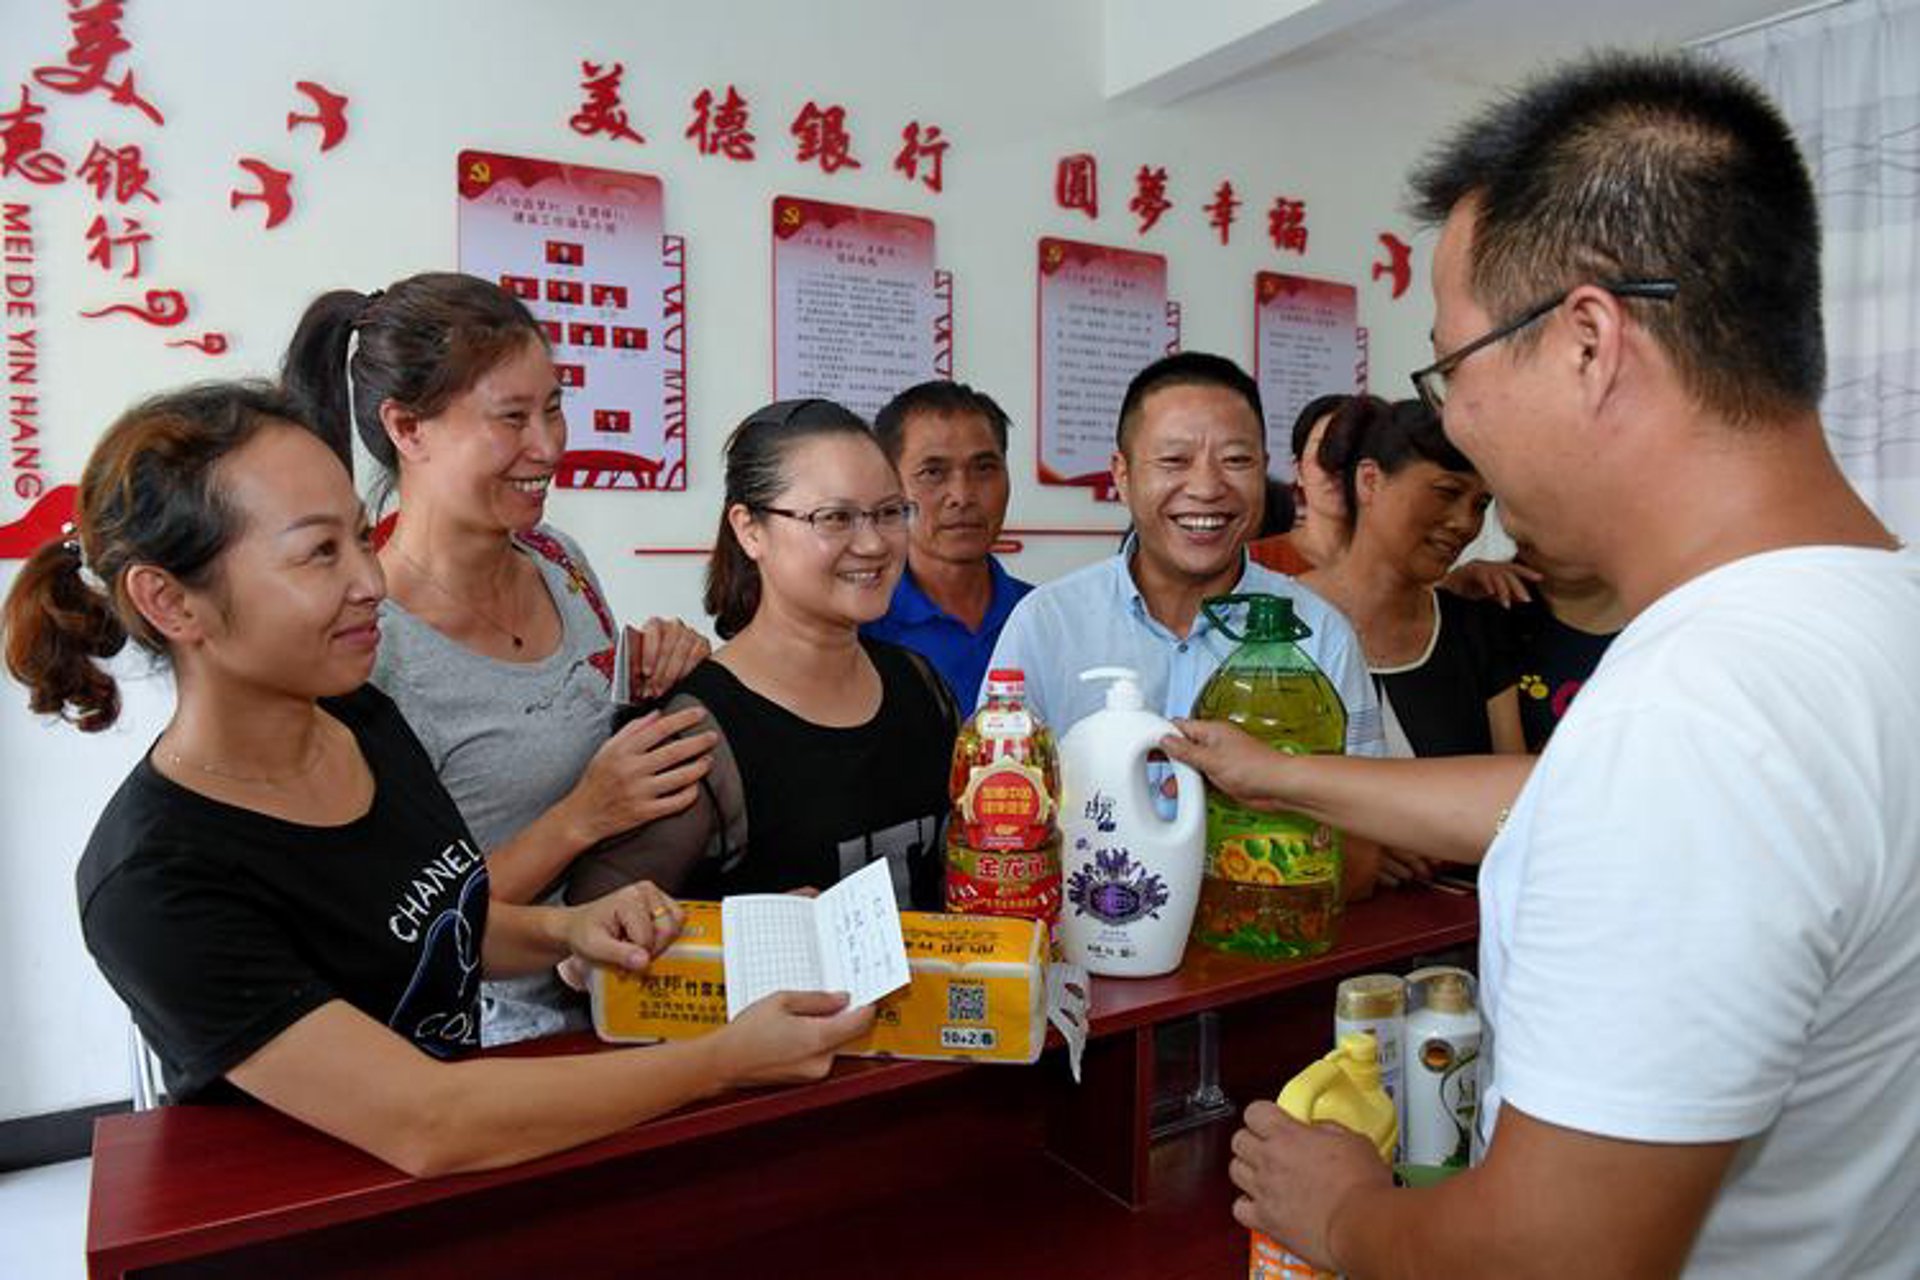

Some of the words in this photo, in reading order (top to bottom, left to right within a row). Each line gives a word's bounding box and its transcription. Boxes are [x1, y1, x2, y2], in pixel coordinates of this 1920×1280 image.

[3, 204, 32, 264] MEI
[3, 273, 36, 319] DE
[5, 329, 37, 387] YIN
[8, 395, 44, 500] HANG
[388, 838, 481, 943] CHANEL
